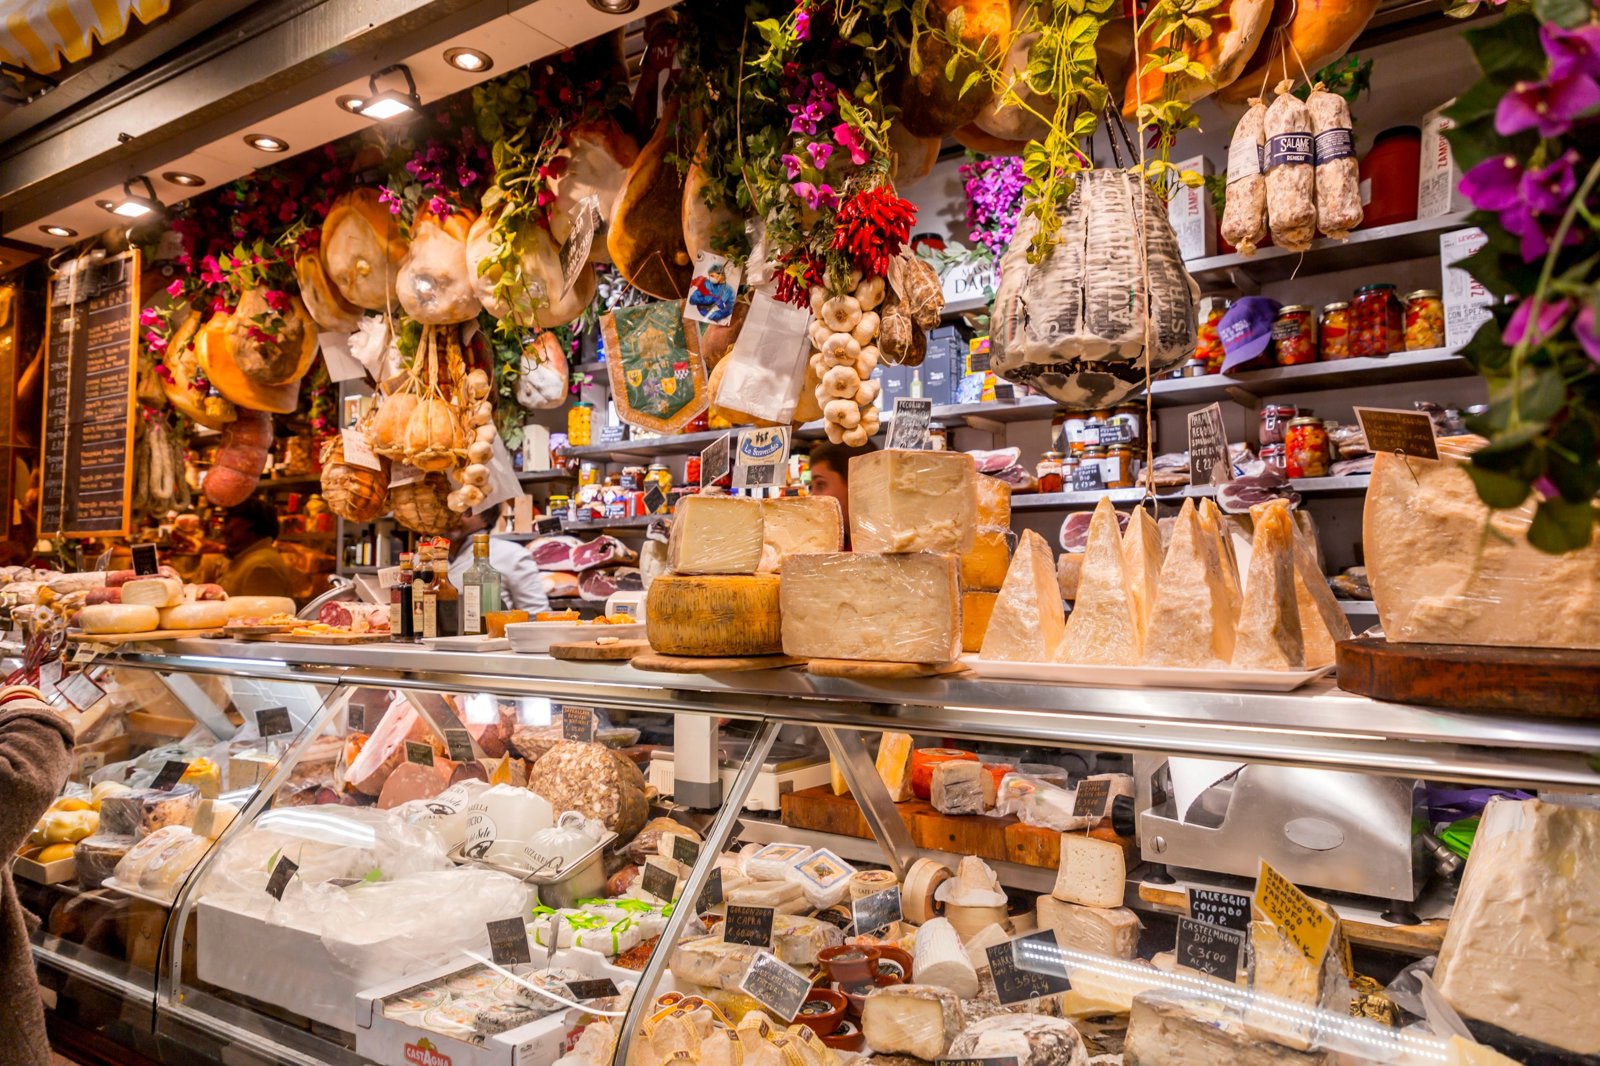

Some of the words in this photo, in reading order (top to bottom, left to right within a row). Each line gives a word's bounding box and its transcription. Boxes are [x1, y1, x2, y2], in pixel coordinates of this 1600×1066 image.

[1280, 138, 1310, 152] SALAME
[1195, 890, 1247, 906] TALEGGIO
[1266, 877, 1302, 913] CREMOSO
[1307, 916, 1316, 928] AL
[1267, 867, 1323, 923] GORGONZOLA
[1193, 901, 1242, 917] COLOMBO
[1265, 885, 1303, 925] TARTUFO
[736, 916, 762, 925] CAPRA
[1182, 920, 1240, 945] CASTELMAGNO
[1194, 933, 1213, 945] DOP
[1190, 957, 1200, 966] AL
[406, 1046, 444, 1066] CASTAGNA
